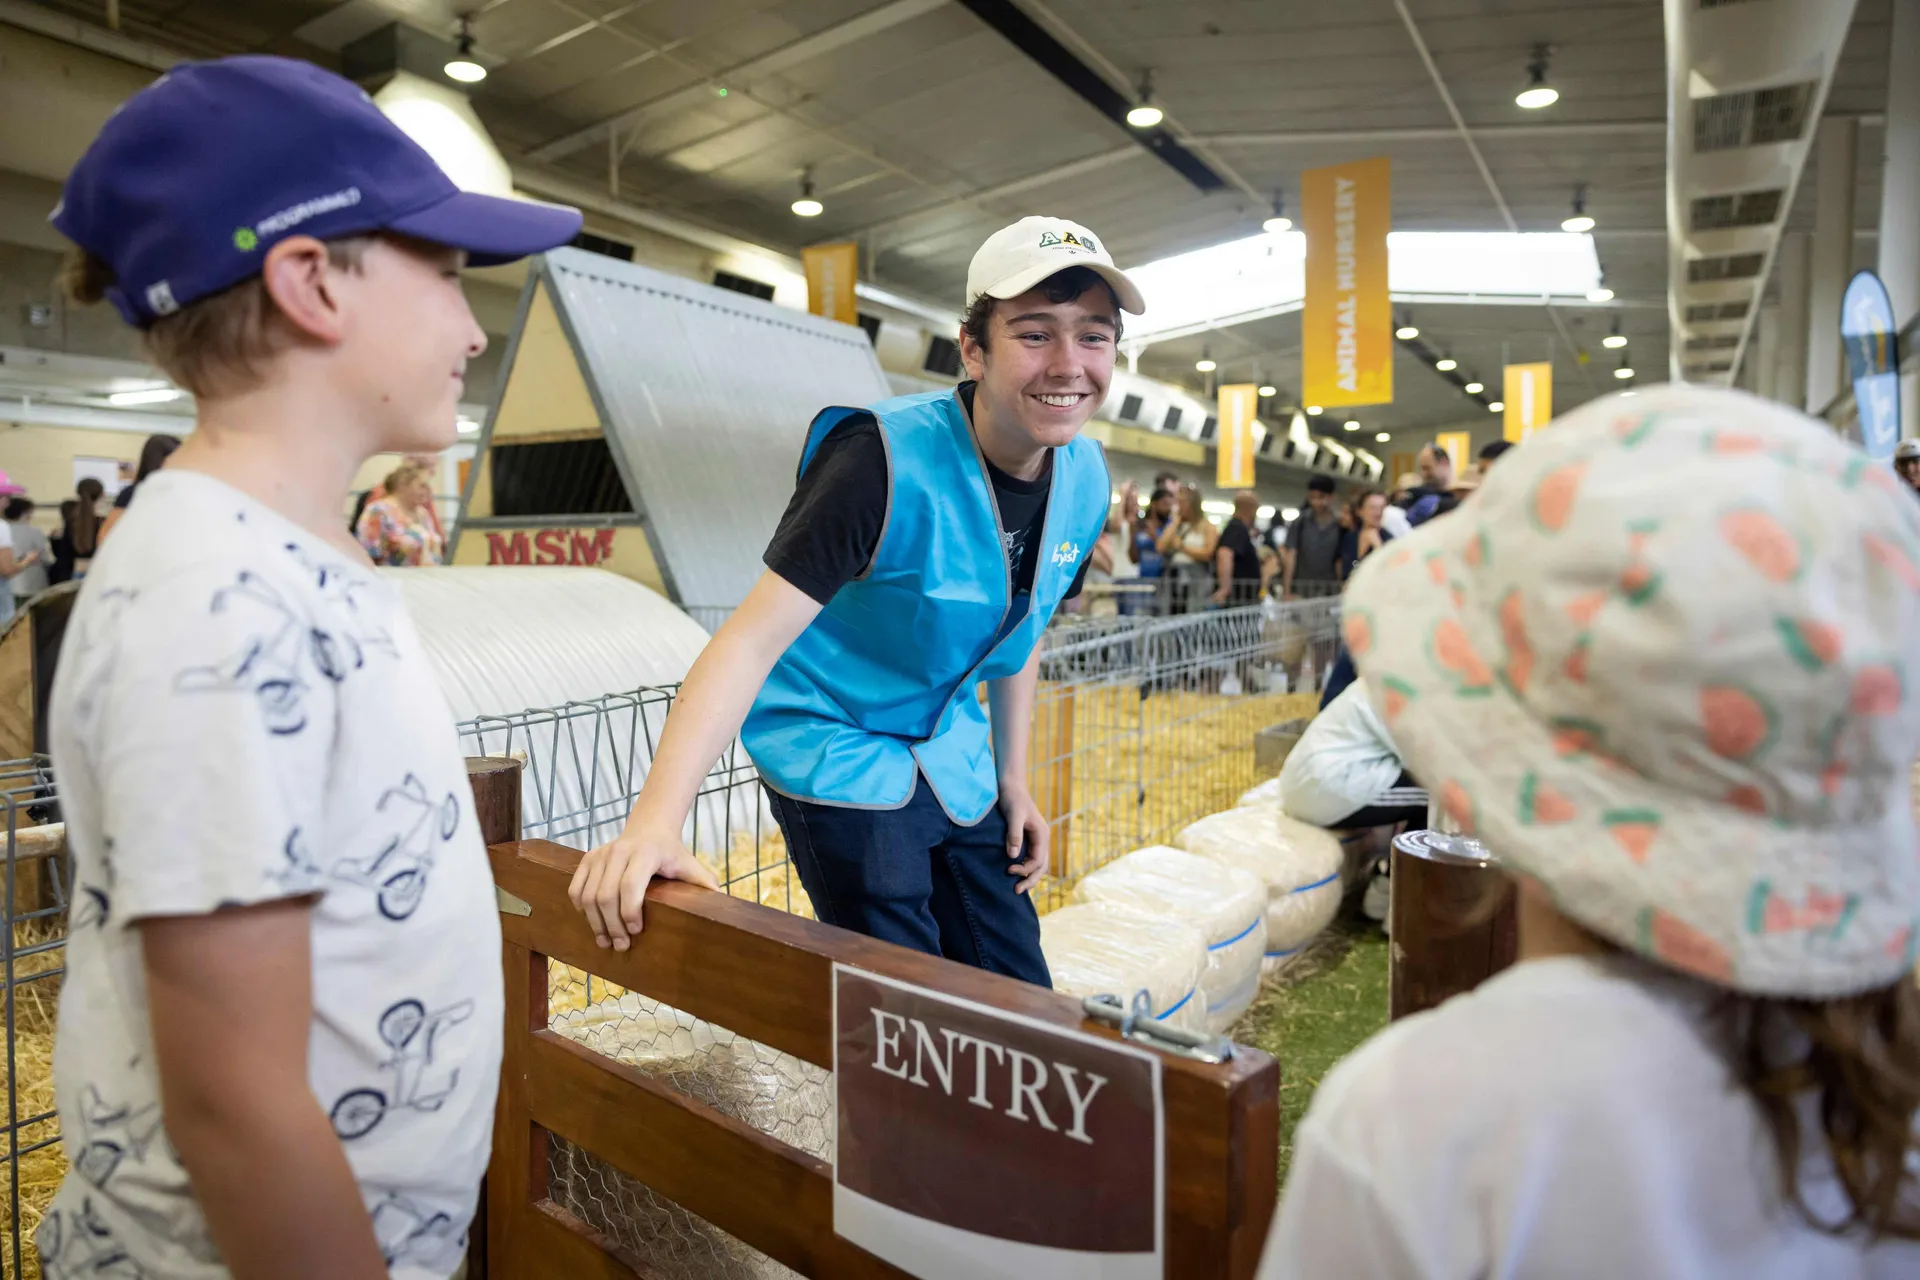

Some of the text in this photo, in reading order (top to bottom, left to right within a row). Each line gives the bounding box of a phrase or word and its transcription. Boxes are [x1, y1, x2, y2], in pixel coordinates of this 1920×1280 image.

[1334, 176, 1357, 392] ANIMAL NURSERY
[485, 527, 616, 566] MSM
[870, 1007, 1108, 1145] ENTRY
